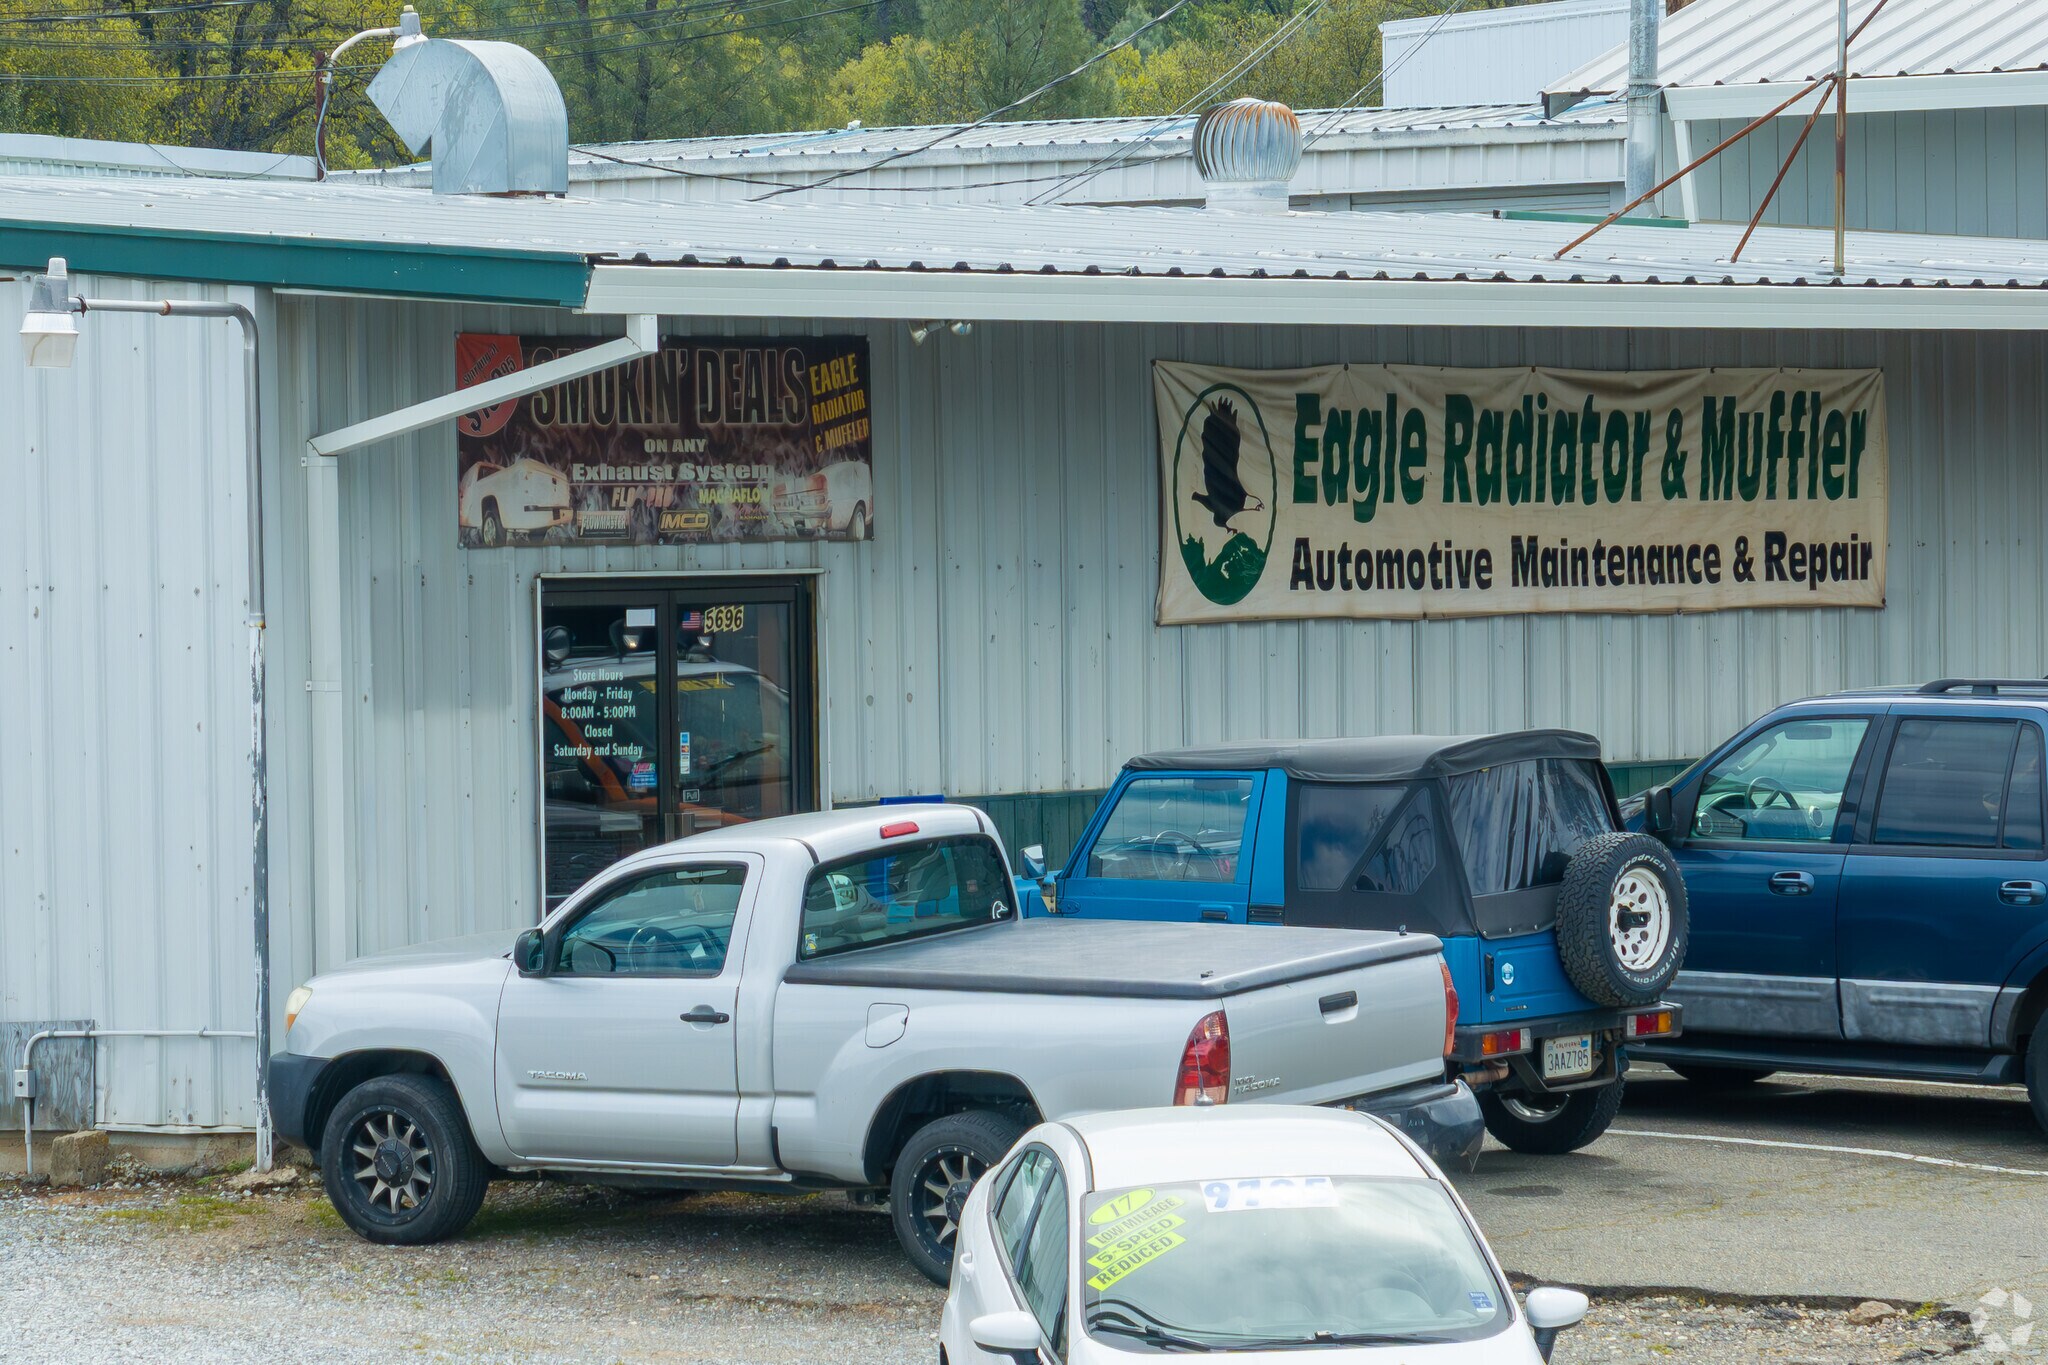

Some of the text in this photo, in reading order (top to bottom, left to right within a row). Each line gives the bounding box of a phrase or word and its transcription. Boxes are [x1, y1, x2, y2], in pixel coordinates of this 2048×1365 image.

[809, 353, 859, 396] EAGLE
[696, 348, 808, 425] DEALS
[812, 389, 866, 425] RADIATOR
[644, 438, 707, 453] ON ANY
[824, 418, 869, 450] MUFFLER
[1292, 389, 1868, 524] Eagle Radiator & Muffler
[572, 463, 775, 482] Exhaust System
[661, 513, 710, 529] IMCO
[1289, 531, 1873, 592] Automotive Maintenance & Repair
[706, 608, 743, 630] 5696
[573, 668, 624, 682] Store Hours
[564, 687, 597, 703] Monday
[606, 687, 633, 703] Friday
[561, 706, 594, 720] 8:00AM
[604, 706, 636, 719] 5:00PM
[584, 724, 613, 738] Closed
[554, 743, 643, 760] Saturday and Sunday
[1547, 1049, 1589, 1072] 3AAZ785
[527, 1070, 588, 1081] TACOMA
[1110, 1194, 1132, 1217] 17
[1095, 1198, 1176, 1245] LOW MILEAGE
[1096, 1218, 1174, 1264] 5-SPEED
[1096, 1236, 1174, 1285] REDUCED
